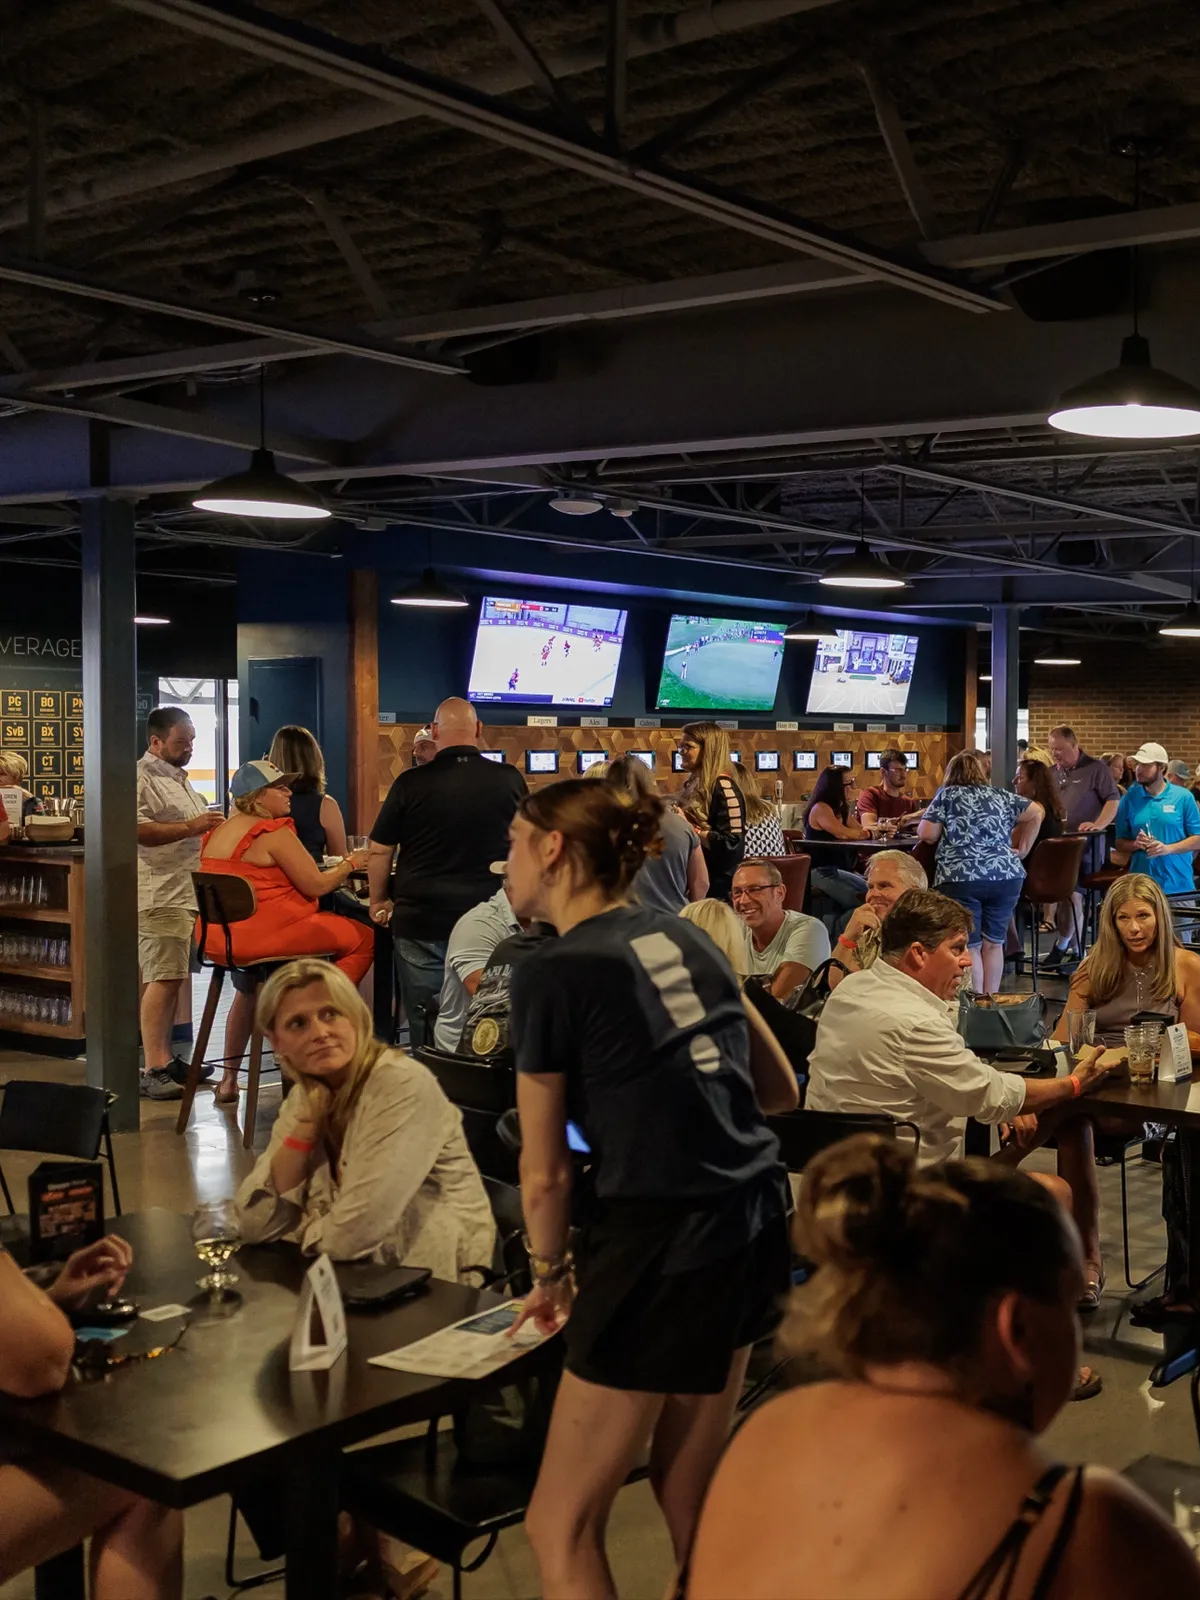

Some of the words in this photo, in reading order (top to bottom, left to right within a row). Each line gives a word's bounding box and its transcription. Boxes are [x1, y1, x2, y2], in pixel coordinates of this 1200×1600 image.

[8, 696, 22, 707] PG
[41, 726, 54, 737] BX
[41, 755, 54, 766] CT
[42, 785, 54, 796] RJ
